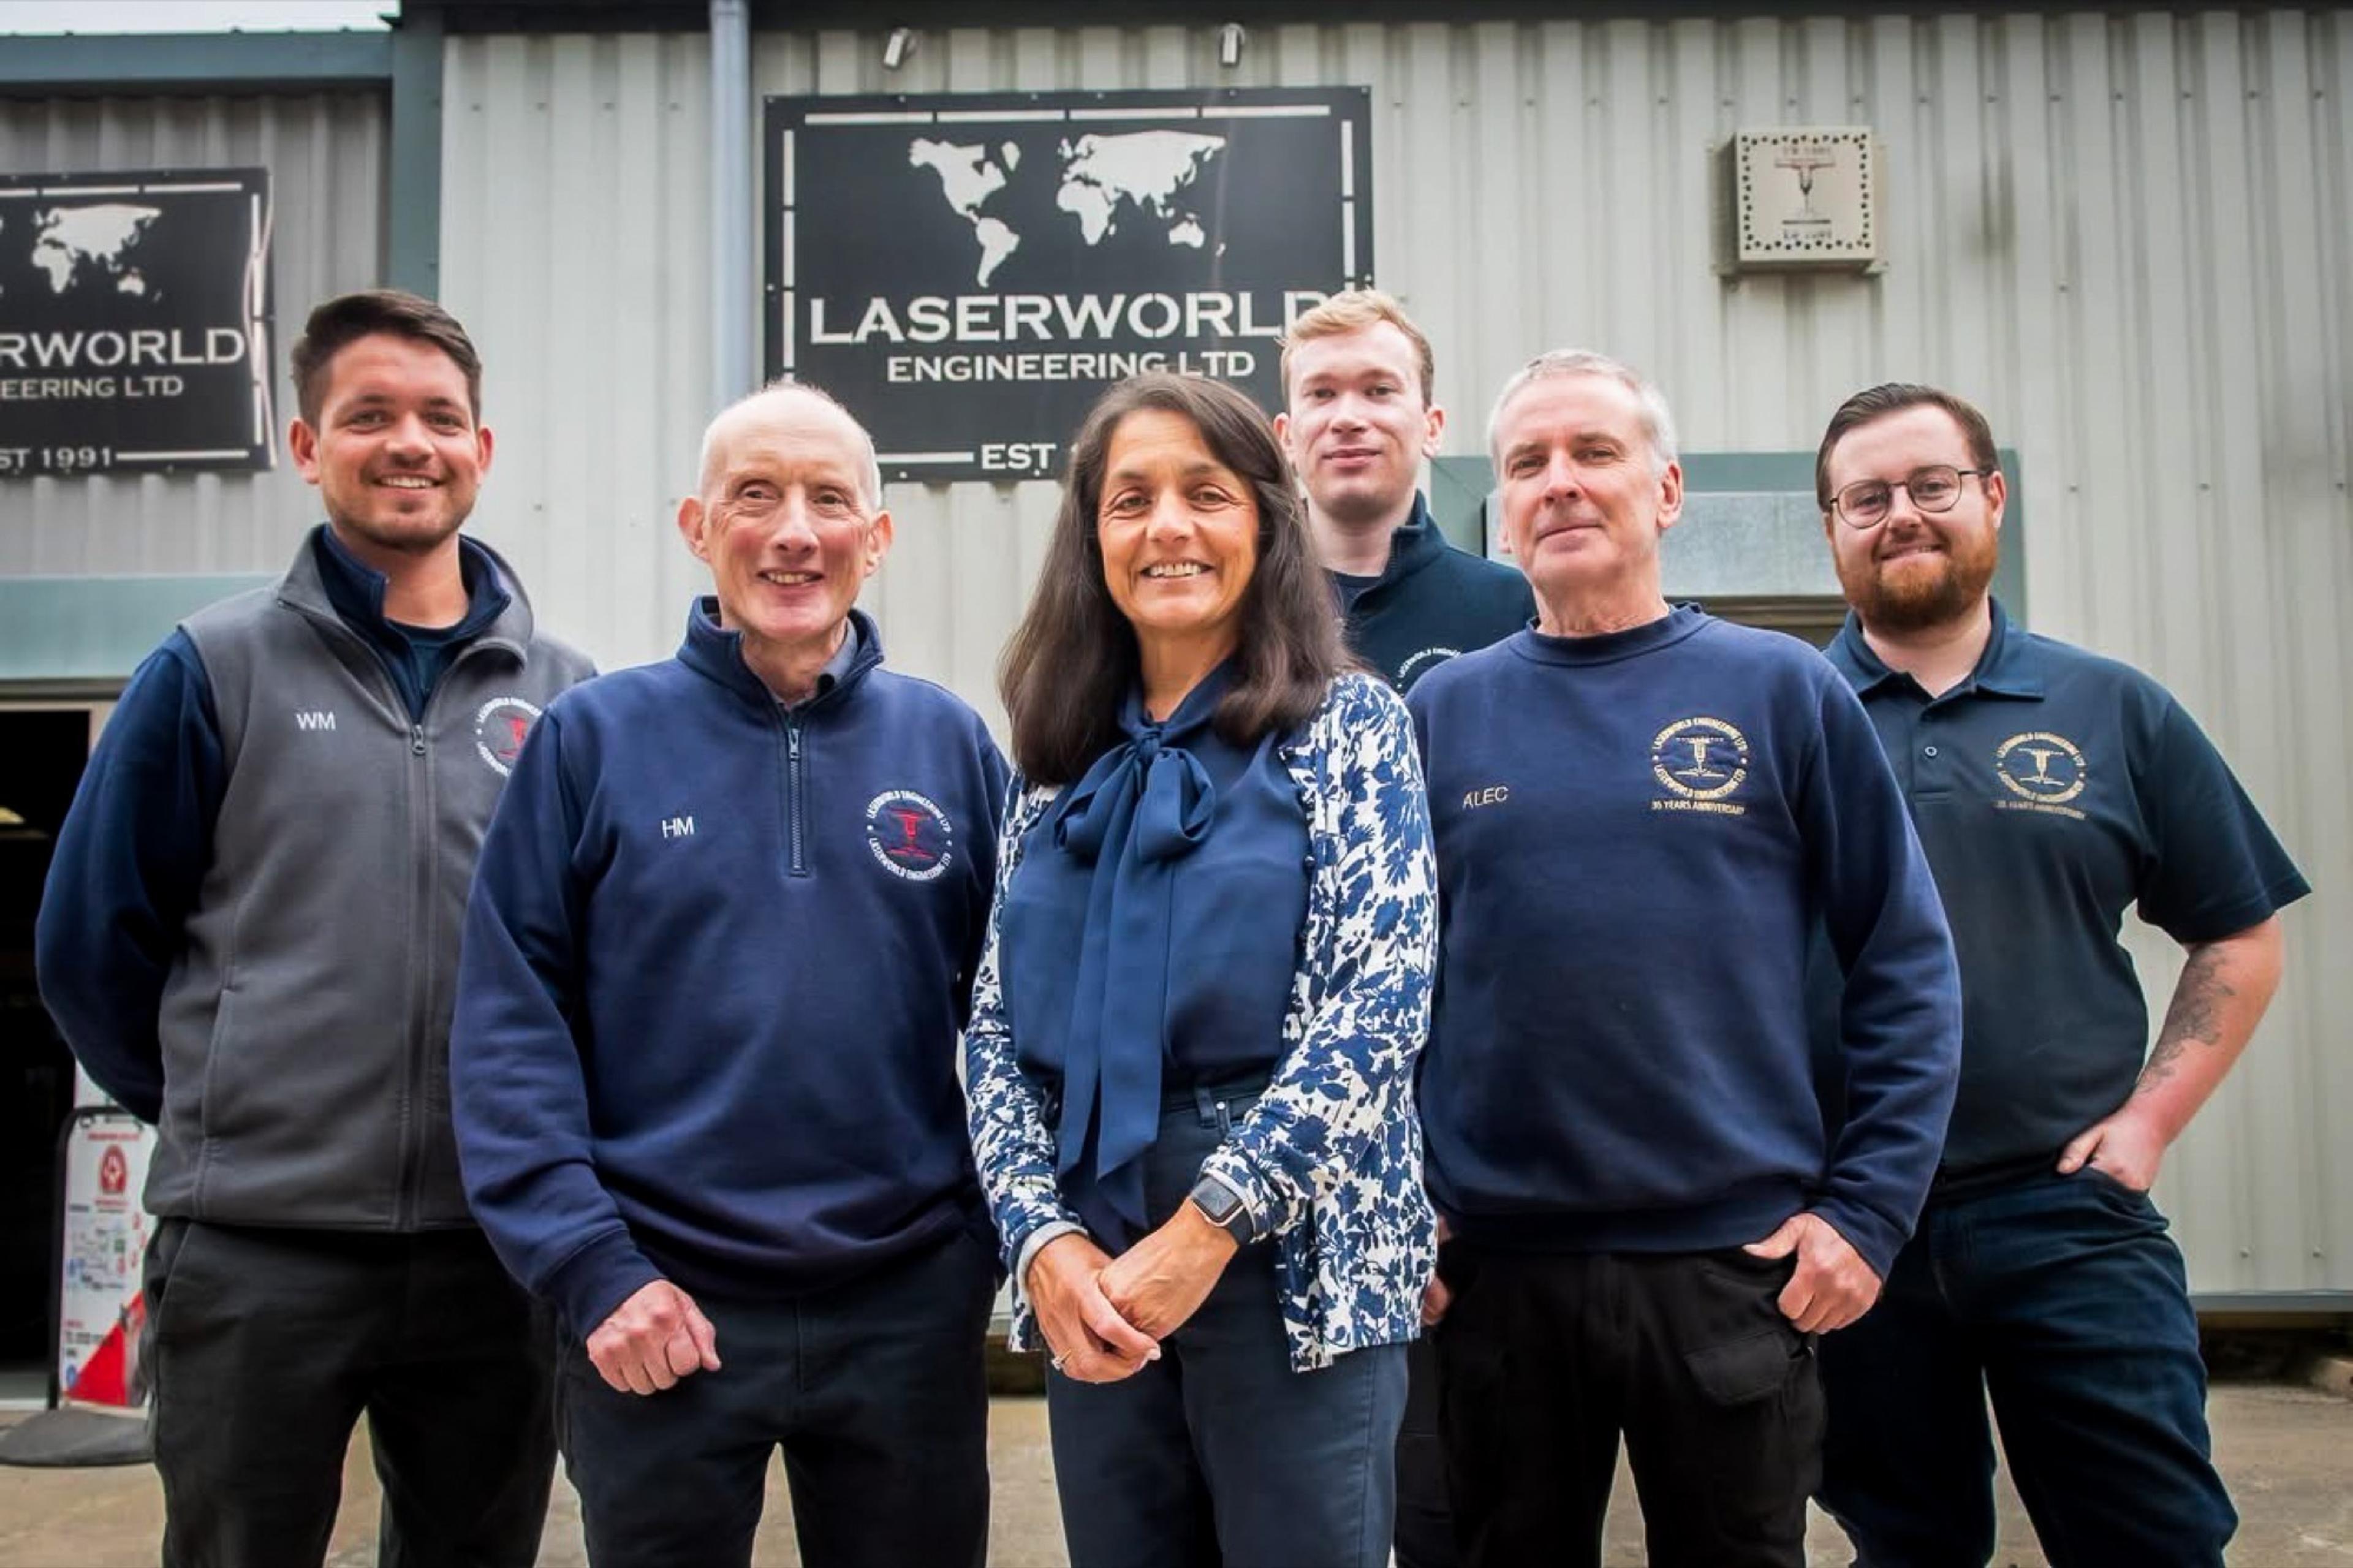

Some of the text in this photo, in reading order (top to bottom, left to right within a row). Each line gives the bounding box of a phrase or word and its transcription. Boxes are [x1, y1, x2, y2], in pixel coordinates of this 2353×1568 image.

[887, 352, 1256, 382] ENGINEERING LTD
[125, 375, 184, 397] LTD
[43, 447, 110, 469] 1991
[982, 443, 1056, 469] EST
[297, 711, 336, 730] WM
[1463, 786, 1509, 809] ALEC
[662, 816, 694, 838] HM
